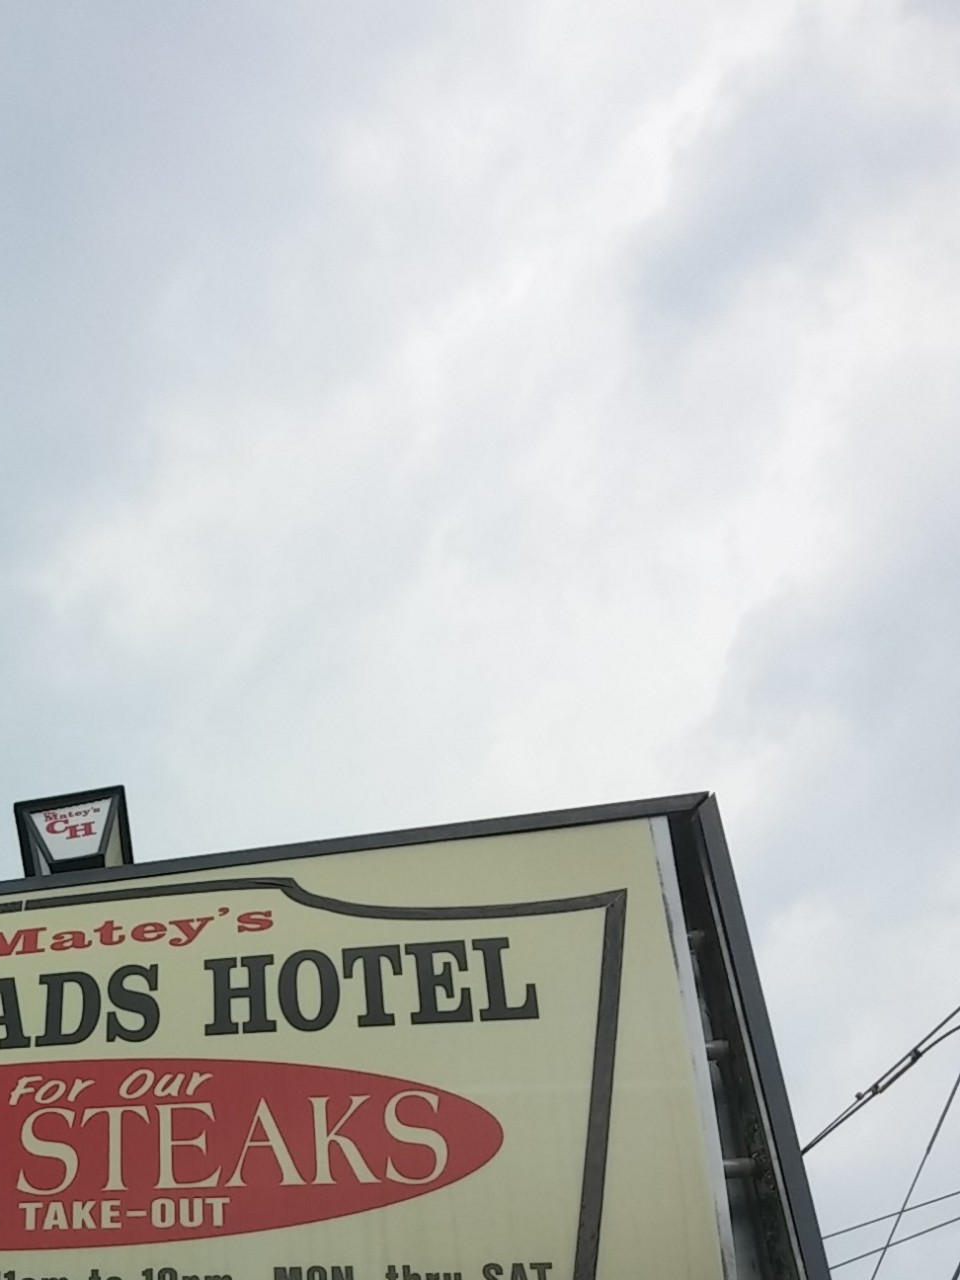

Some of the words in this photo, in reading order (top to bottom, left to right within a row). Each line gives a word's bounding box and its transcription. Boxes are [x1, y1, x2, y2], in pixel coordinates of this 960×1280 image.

[44, 806, 101, 822] Matey's
[45, 819, 97, 840] CH
[203, 937, 540, 1036] HOTEL
[8, 1074, 96, 1107] For
[118, 1068, 213, 1099] Our
[16, 1090, 450, 1197] STEAKS
[19, 1197, 231, 1231] TAKE-OUT
